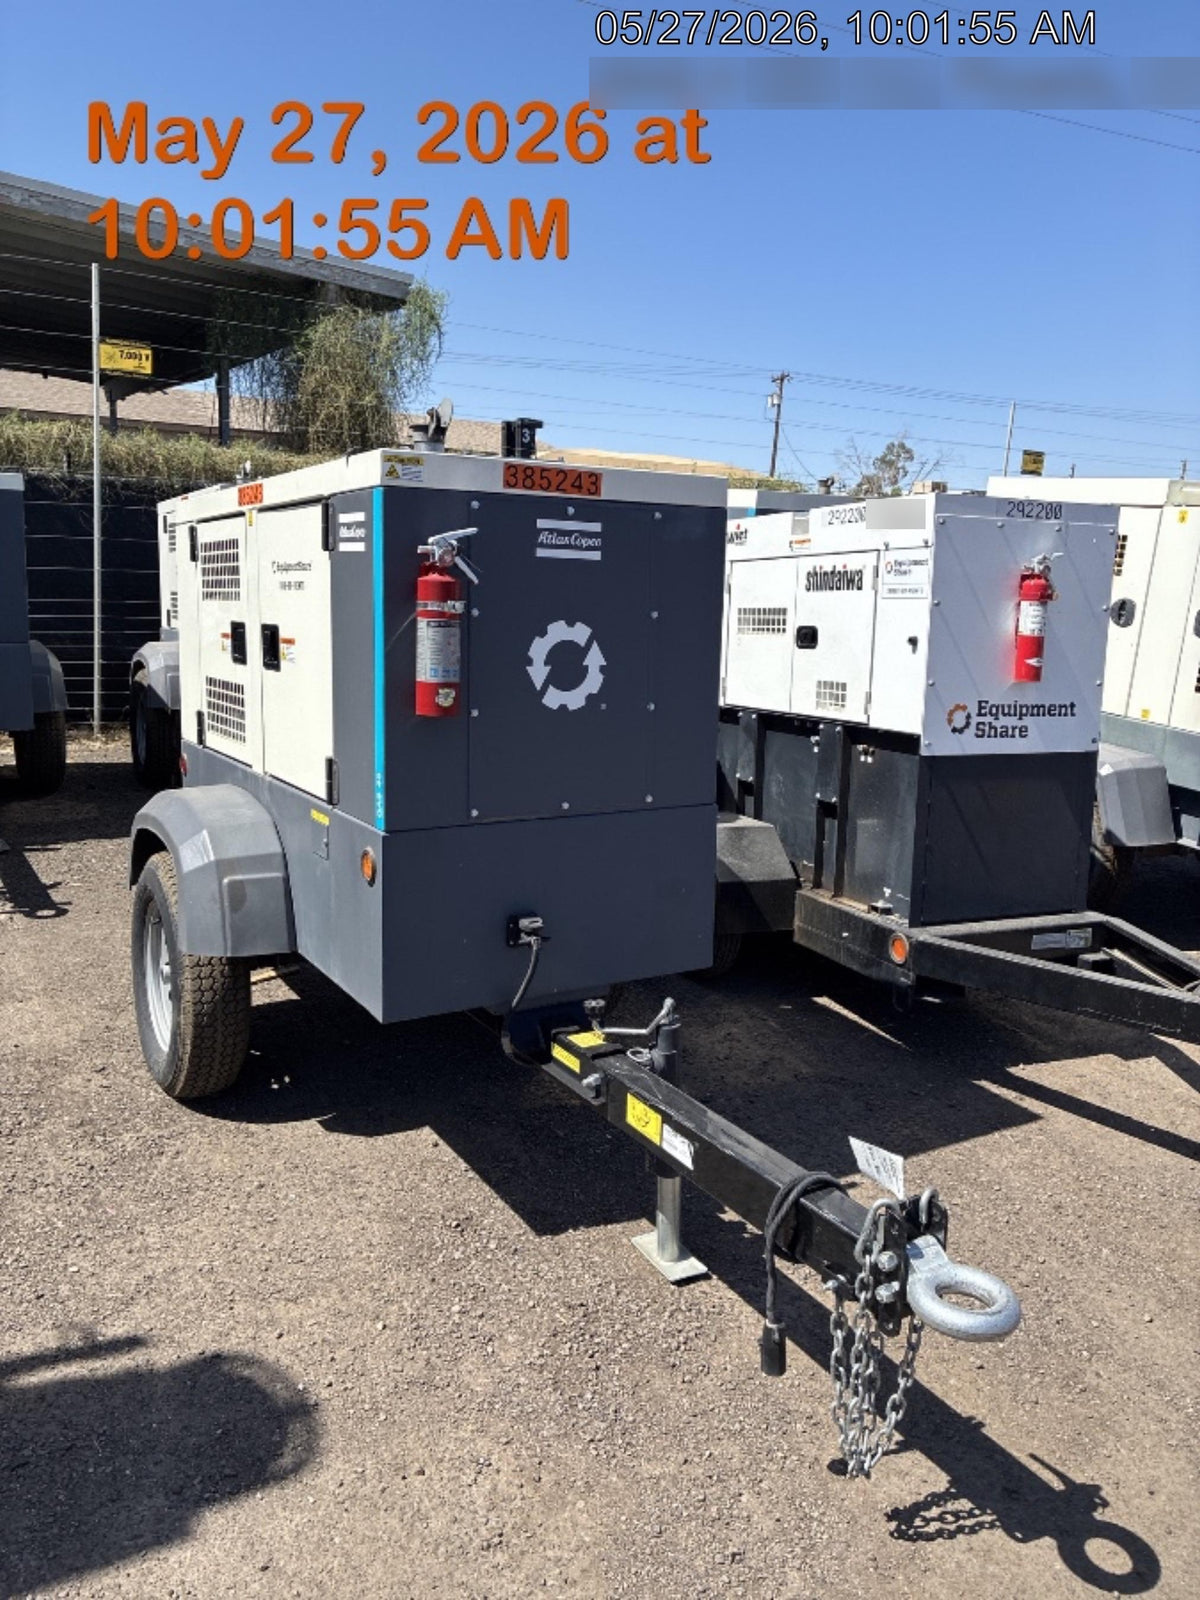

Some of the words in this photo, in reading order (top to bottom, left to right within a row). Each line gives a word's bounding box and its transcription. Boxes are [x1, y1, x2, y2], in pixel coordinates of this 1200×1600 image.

[522, 428, 530, 443] 3
[505, 464, 599, 496] 385243
[1006, 500, 1063, 520] 292200
[805, 563, 863, 592] shindaiwa
[976, 700, 1077, 720] Equipment
[974, 721, 1029, 738] Share
